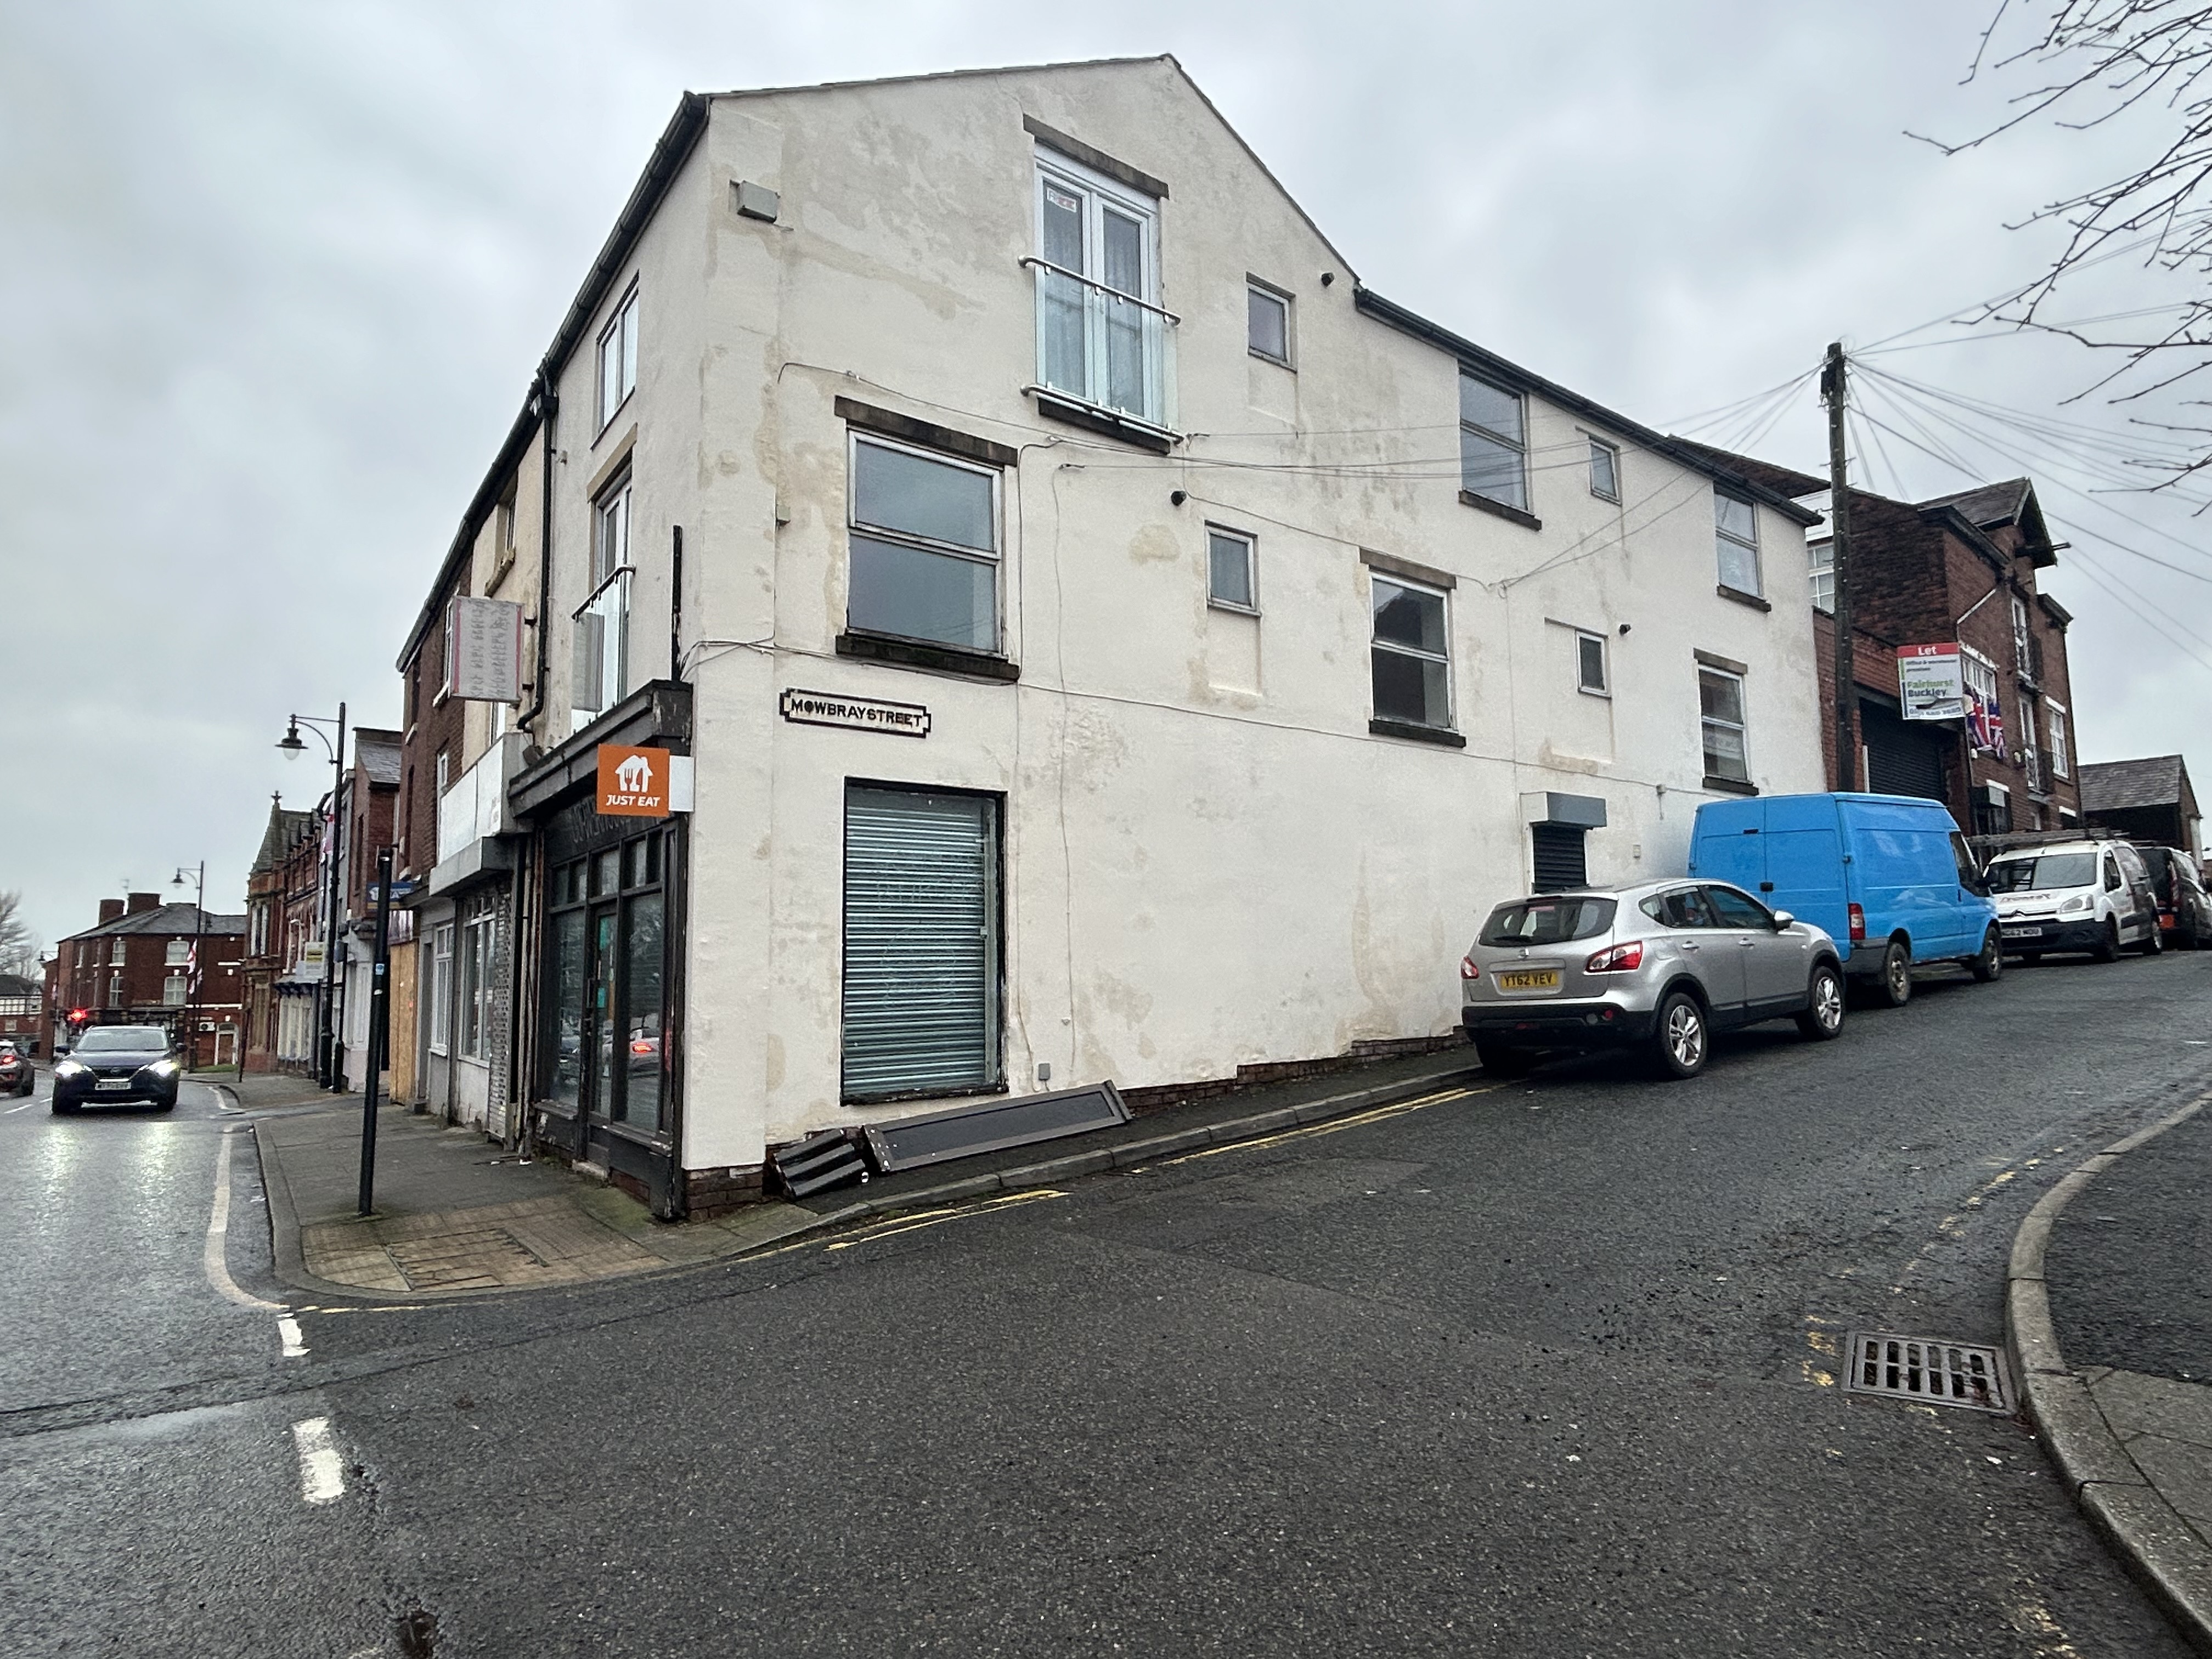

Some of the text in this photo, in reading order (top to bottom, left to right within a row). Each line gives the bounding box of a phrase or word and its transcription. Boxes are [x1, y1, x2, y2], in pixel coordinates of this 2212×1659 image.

[1918, 646, 1937, 655] Let
[1908, 688, 1947, 697] Buckley
[606, 794, 661, 807] JUST EAT
